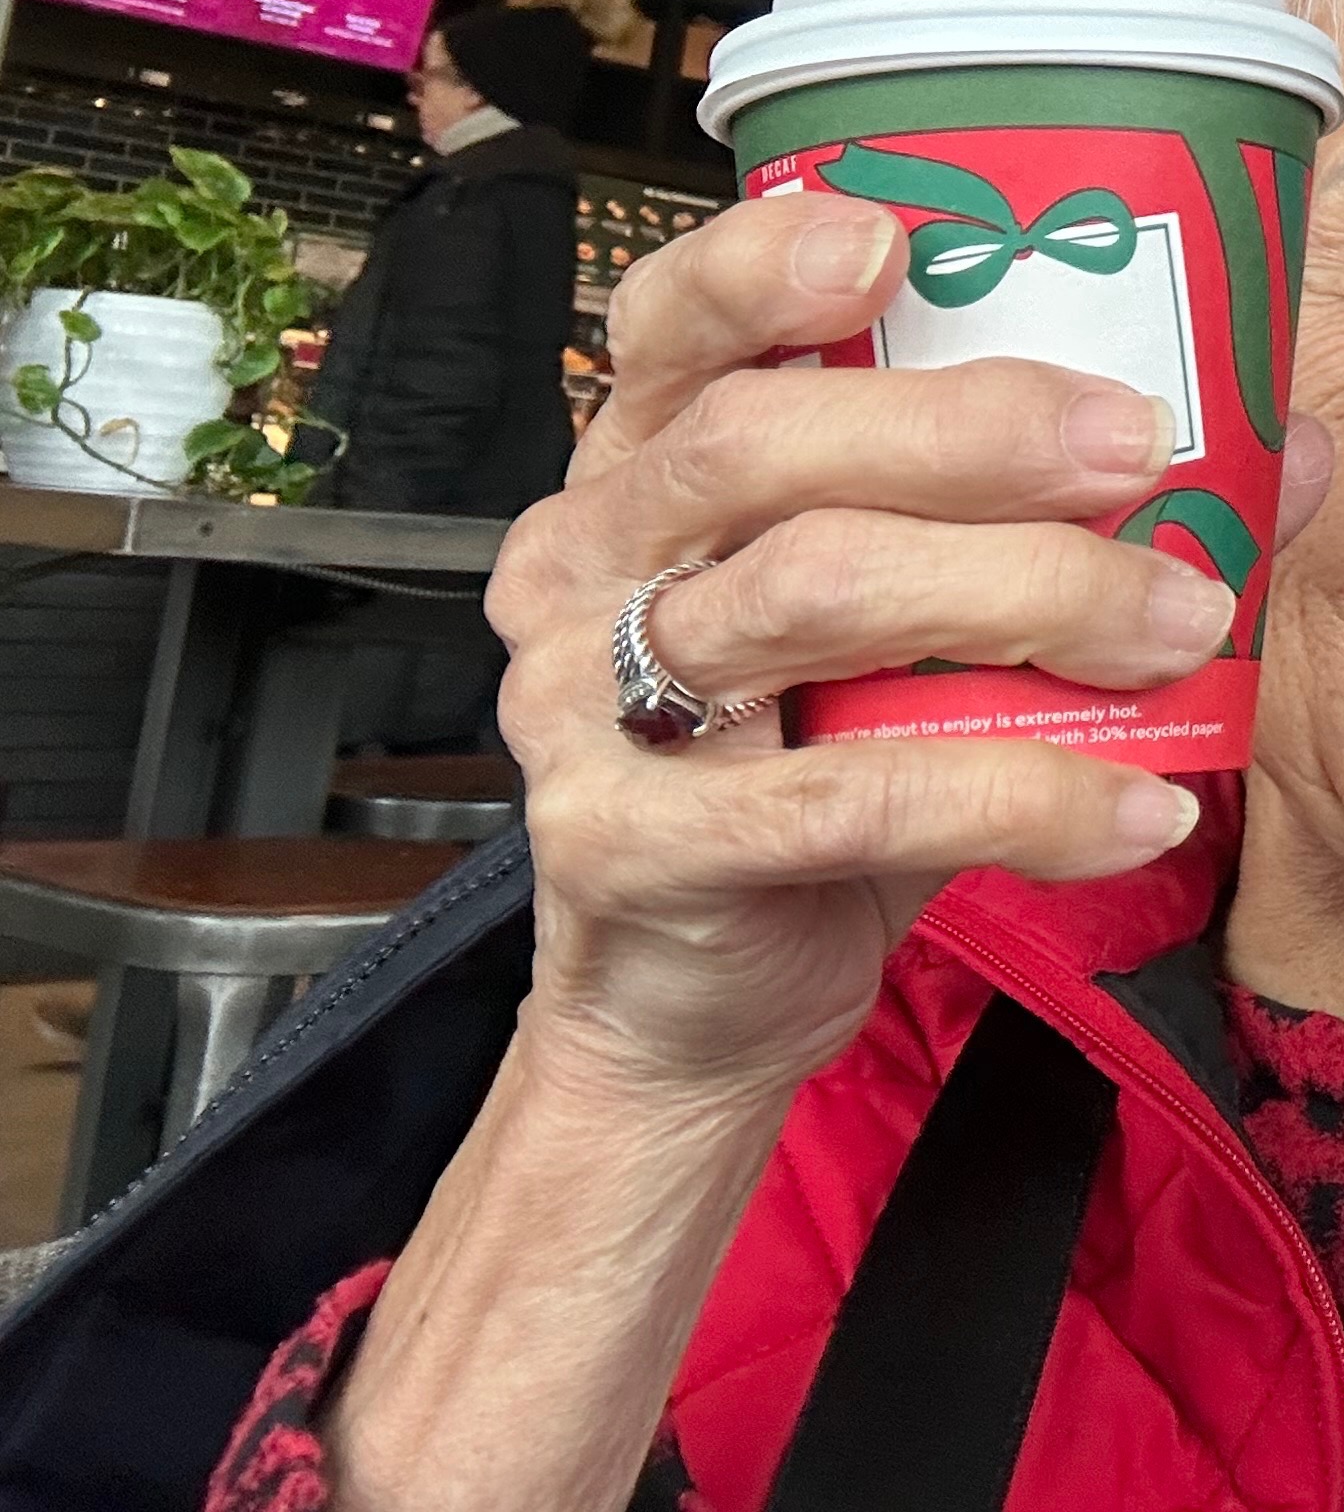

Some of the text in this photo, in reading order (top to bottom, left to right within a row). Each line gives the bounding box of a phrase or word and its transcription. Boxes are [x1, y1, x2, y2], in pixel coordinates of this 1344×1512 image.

[761, 154, 797, 184] DECAF
[873, 722, 918, 739] about
[920, 719, 939, 735] to
[942, 714, 993, 736] enjoy
[996, 712, 1011, 728] is
[1014, 705, 1106, 728] extremely
[1109, 703, 1143, 720] hot.
[1044, 728, 1085, 746] with
[1087, 726, 1128, 744] 30%
[1129, 720, 1190, 742] recycled
